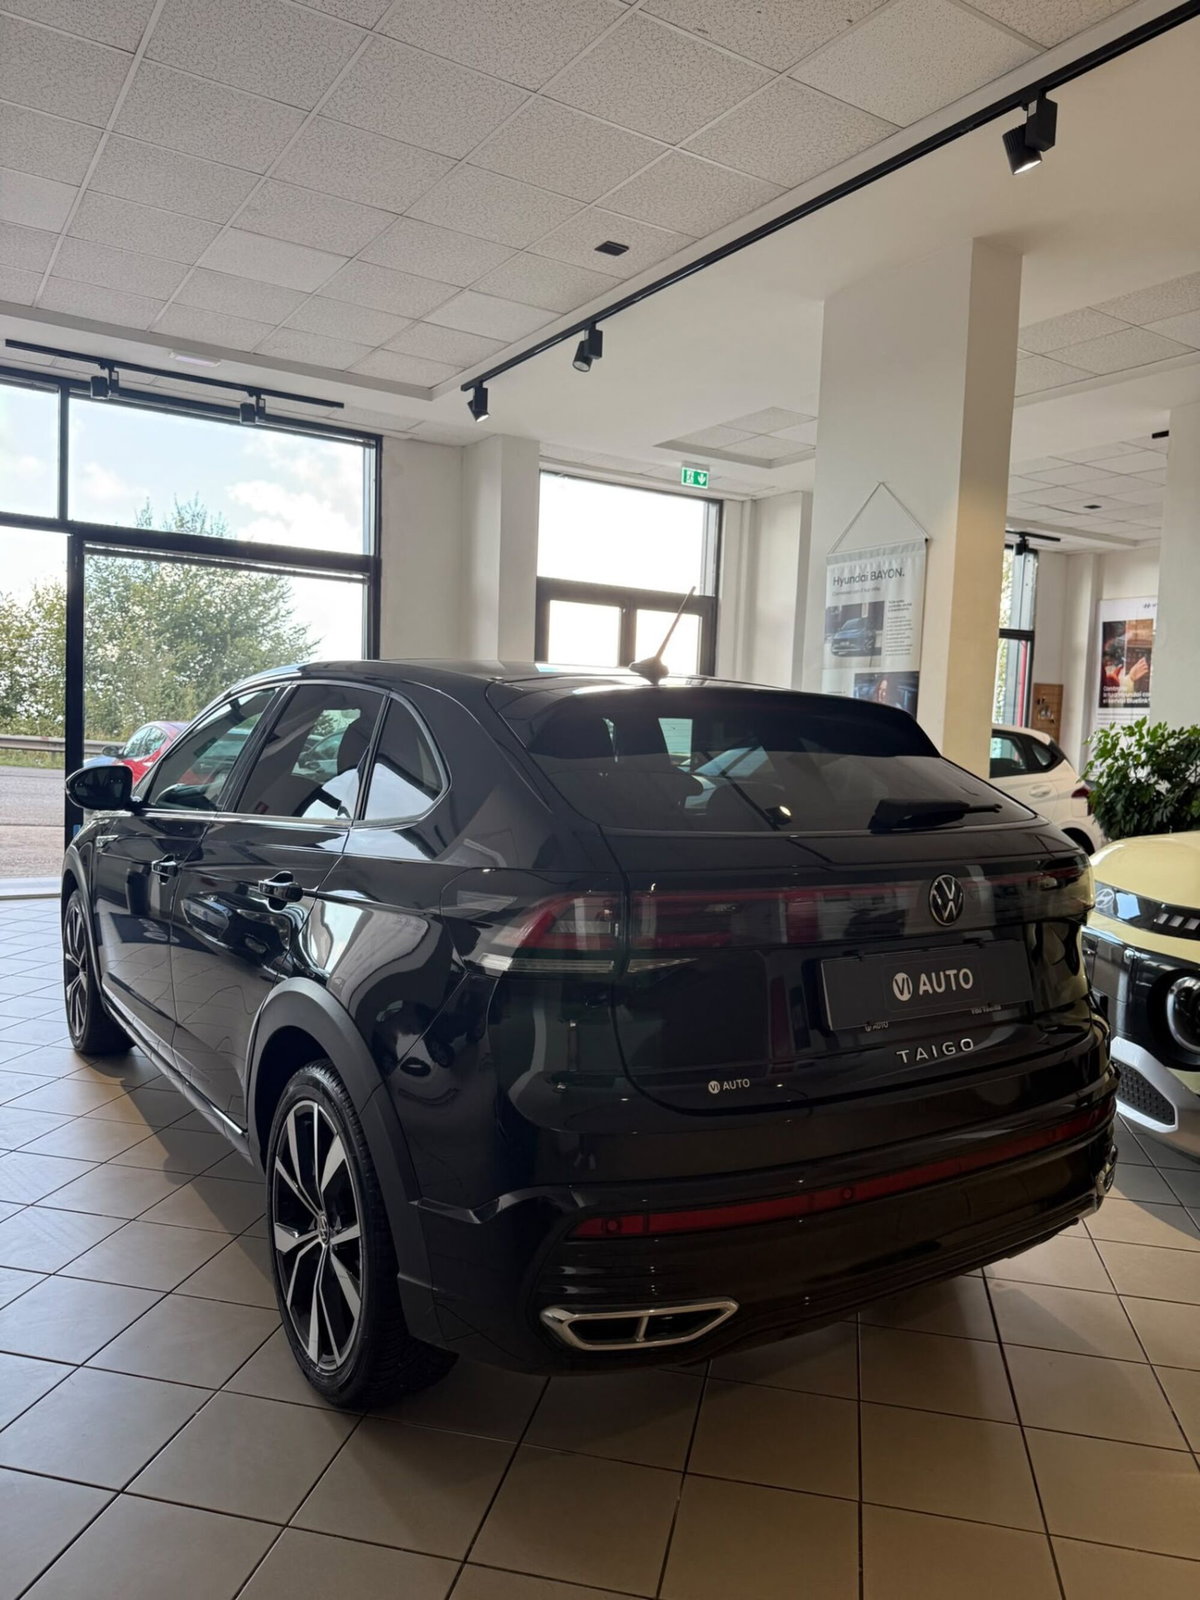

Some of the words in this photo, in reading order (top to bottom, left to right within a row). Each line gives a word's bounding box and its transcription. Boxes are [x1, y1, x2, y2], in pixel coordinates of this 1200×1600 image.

[832, 572, 869, 587] Hyundai
[919, 968, 974, 996] AUTO
[896, 1038, 974, 1064] TAIGO
[722, 1078, 750, 1091] AUTO
